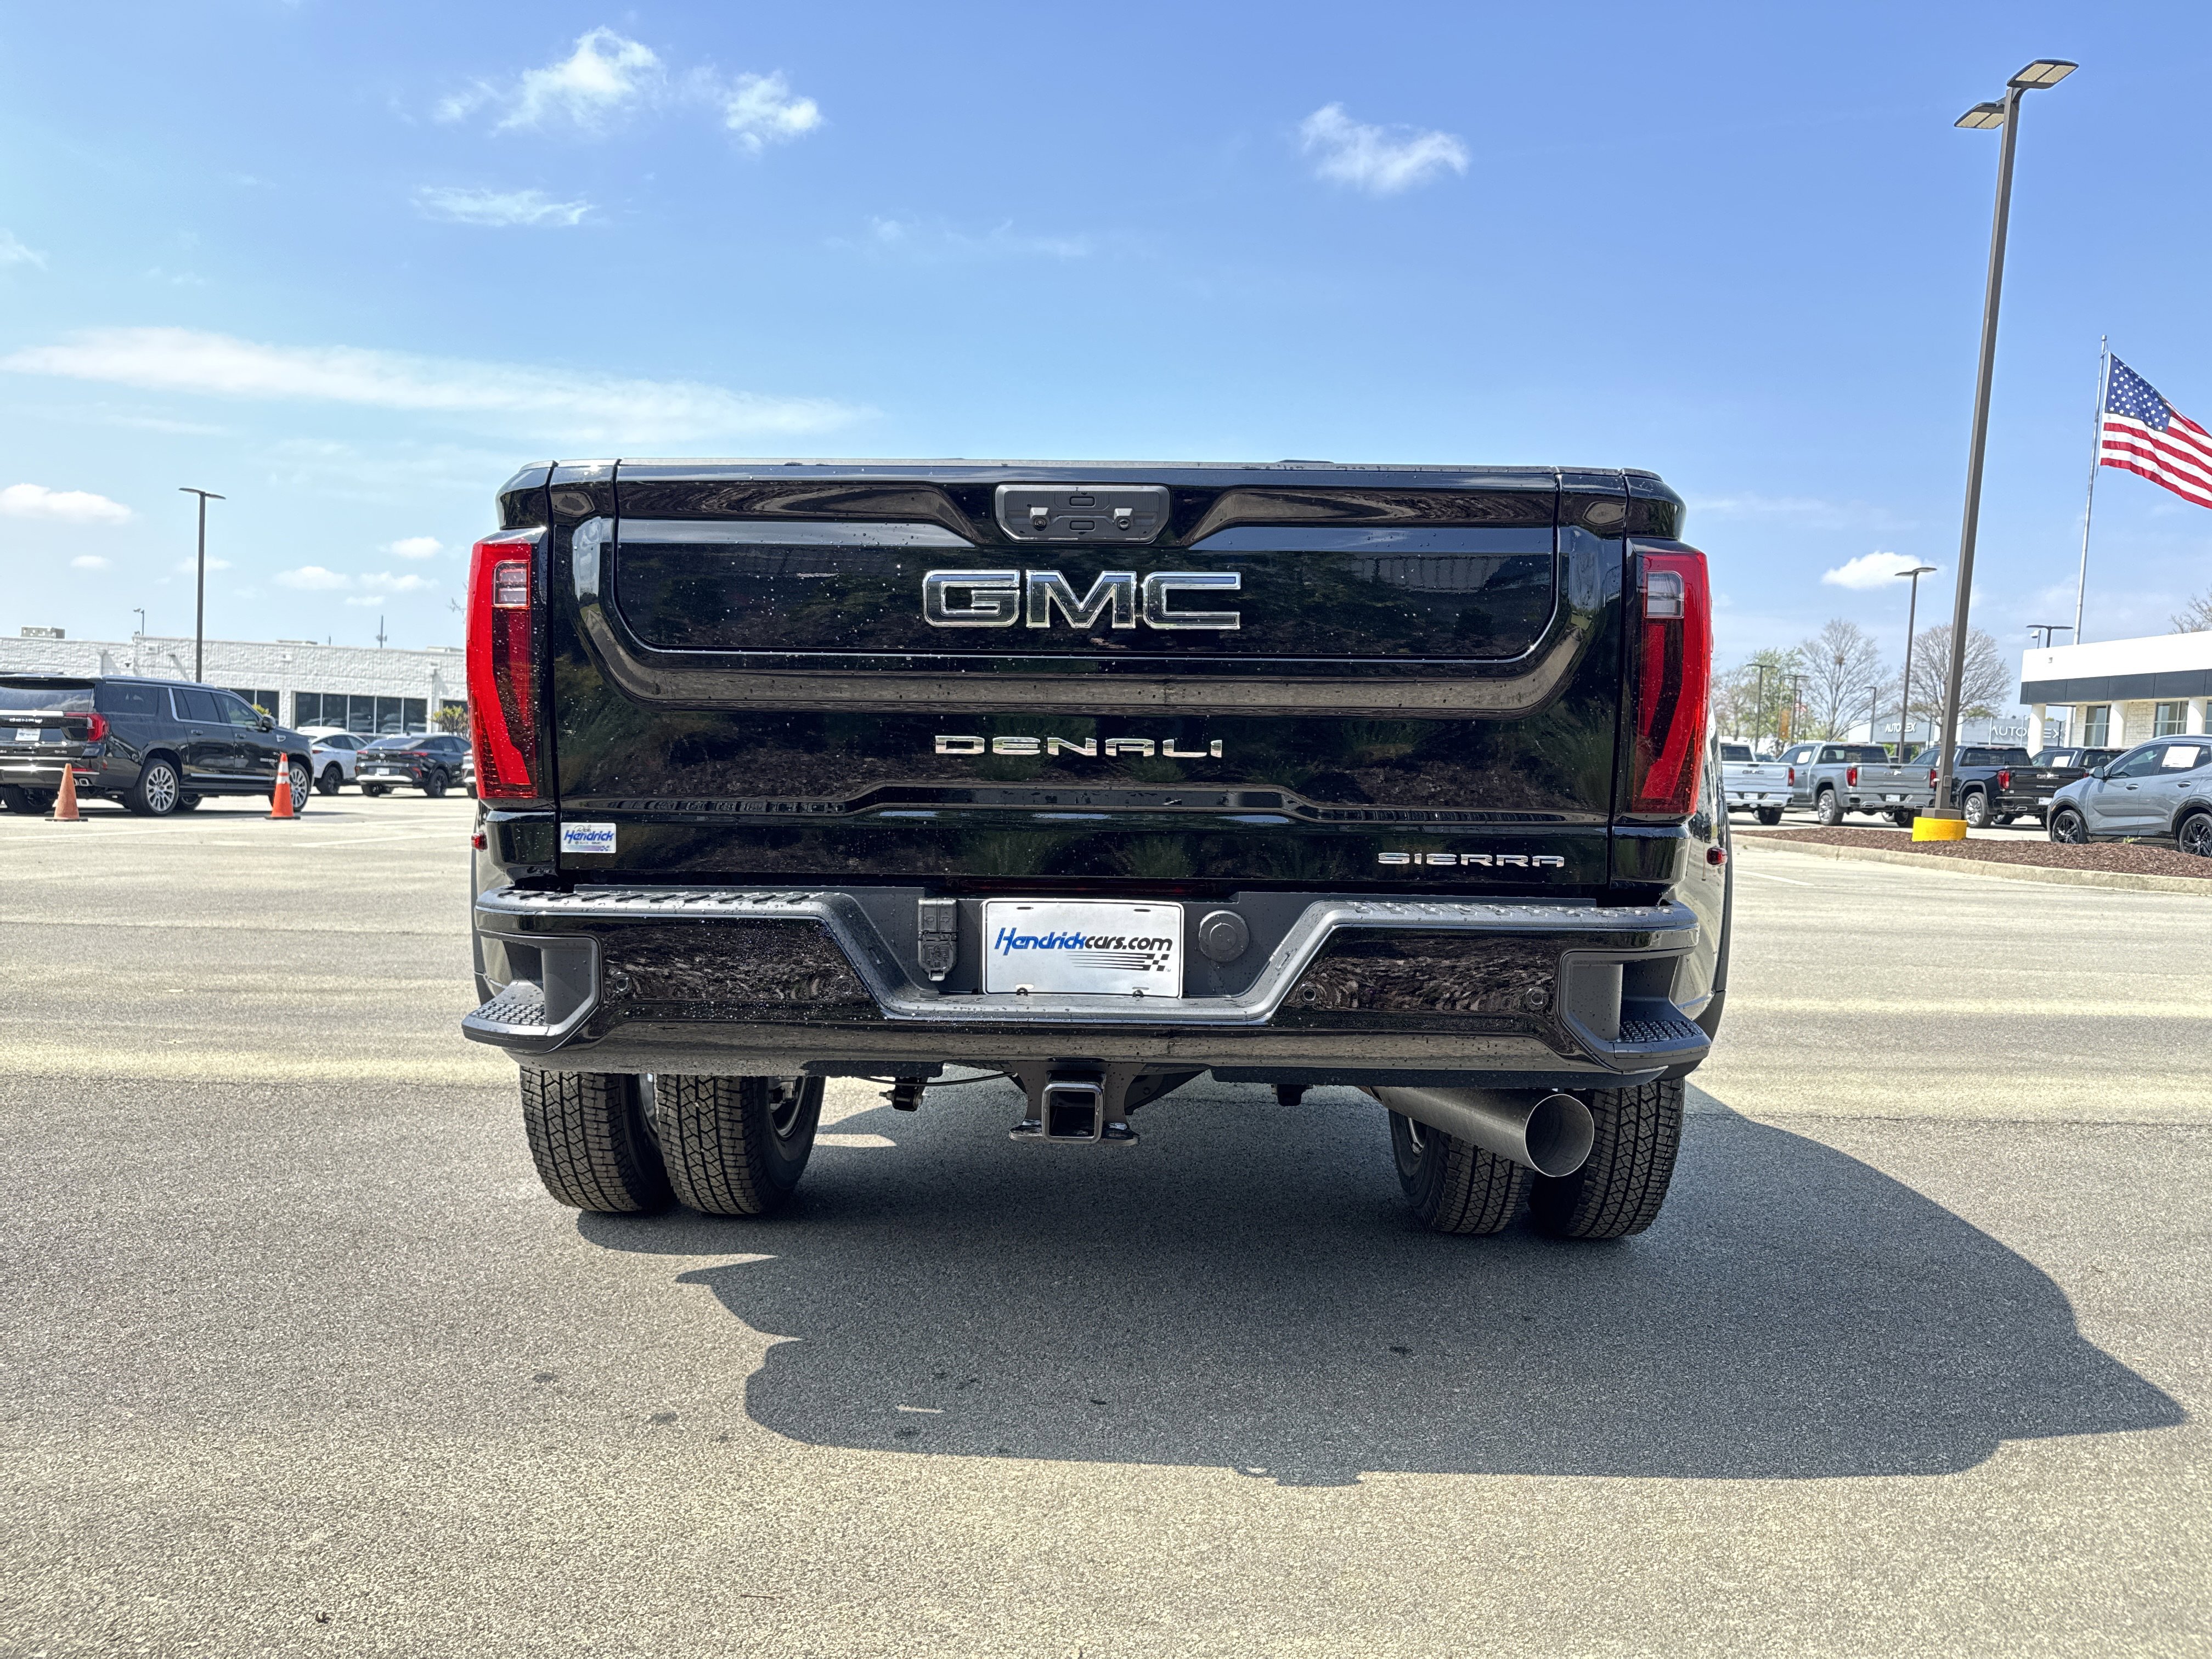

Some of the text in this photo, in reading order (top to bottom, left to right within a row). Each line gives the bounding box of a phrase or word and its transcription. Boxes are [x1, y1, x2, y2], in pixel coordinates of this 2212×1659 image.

[923, 569, 1241, 630] GMC
[1885, 723, 1916, 732] AUTOEX
[1992, 726, 2062, 739] AUTOEX
[935, 735, 1222, 758] DENALI
[563, 830, 614, 844] Hendrick
[1378, 853, 1564, 867] SIERRA
[994, 928, 1173, 956] Hendrickcars.com
